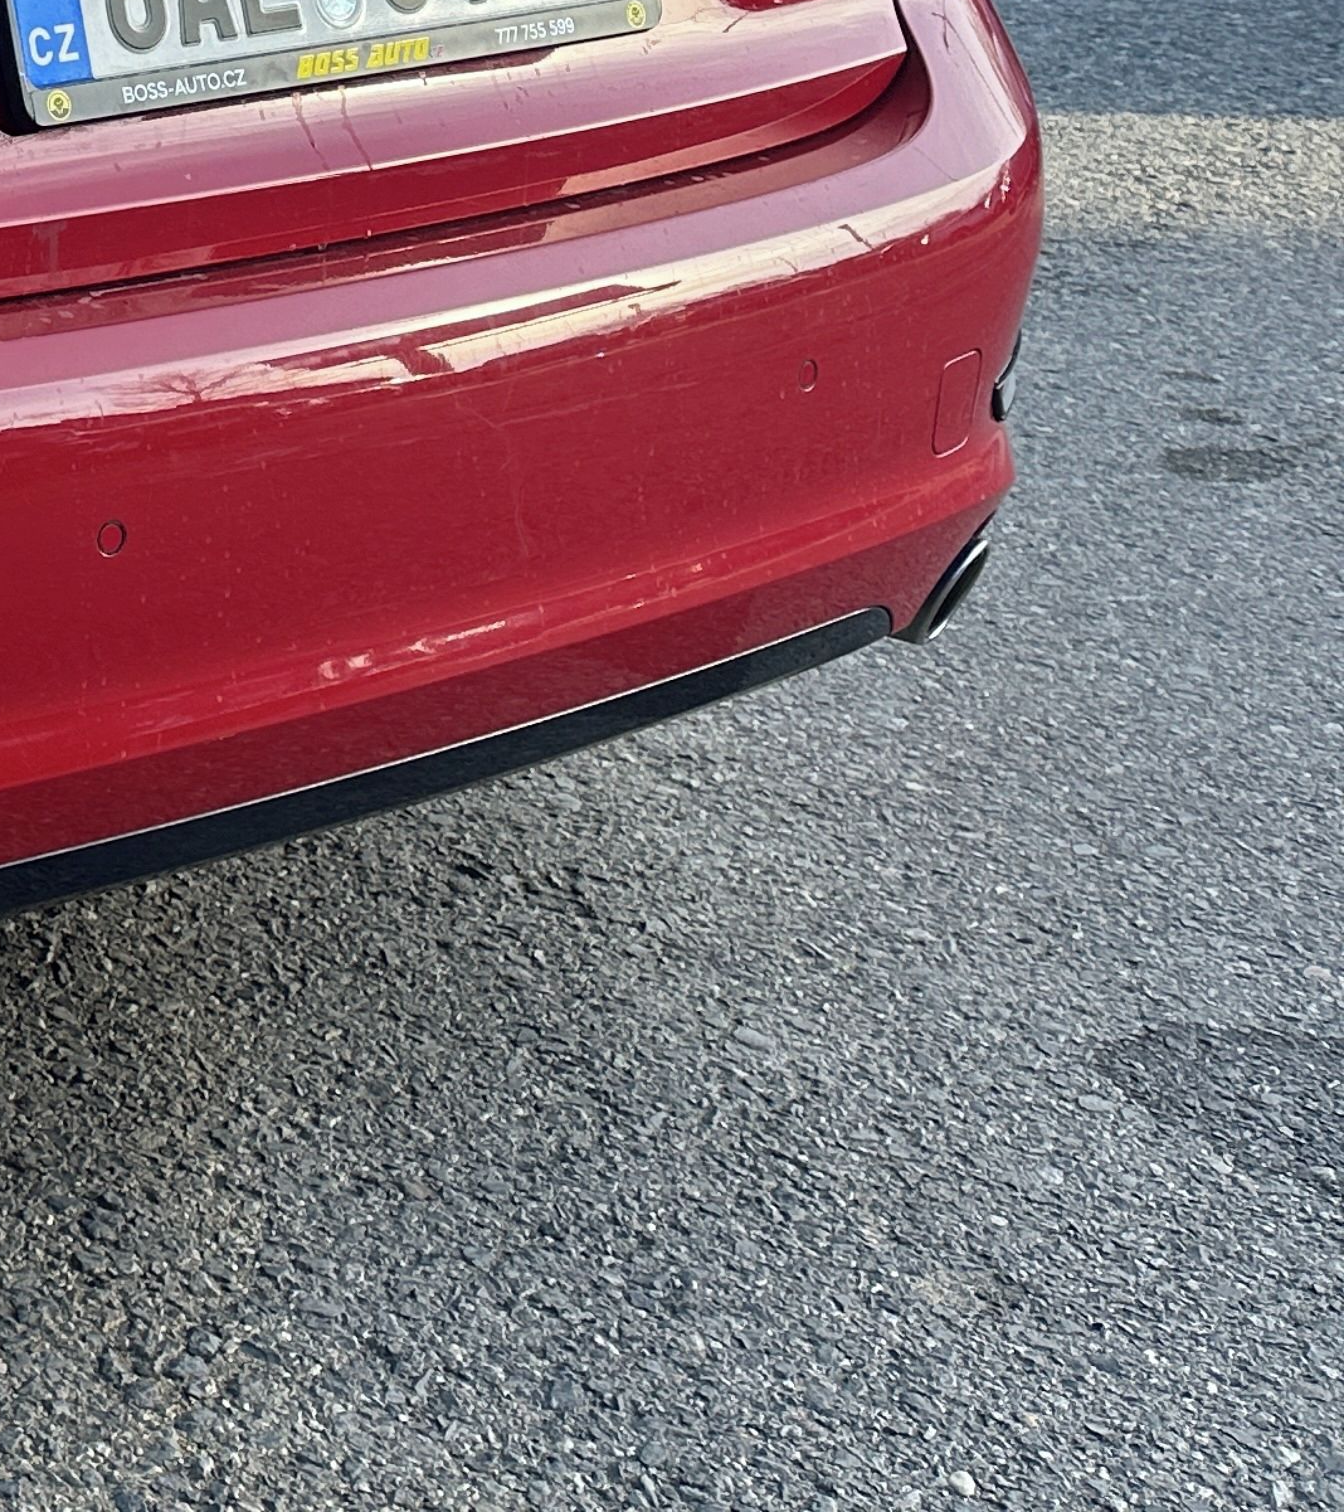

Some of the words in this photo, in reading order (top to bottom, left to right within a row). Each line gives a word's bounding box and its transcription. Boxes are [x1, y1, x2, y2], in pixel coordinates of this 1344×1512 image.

[28, 23, 80, 66] CZ
[495, 27, 519, 45] 777
[522, 21, 547, 41] 755
[549, 16, 575, 36] 599
[297, 50, 359, 79] BOSS
[367, 37, 430, 67] AUTO
[121, 68, 248, 104] BOSS-AUTO.CZ
